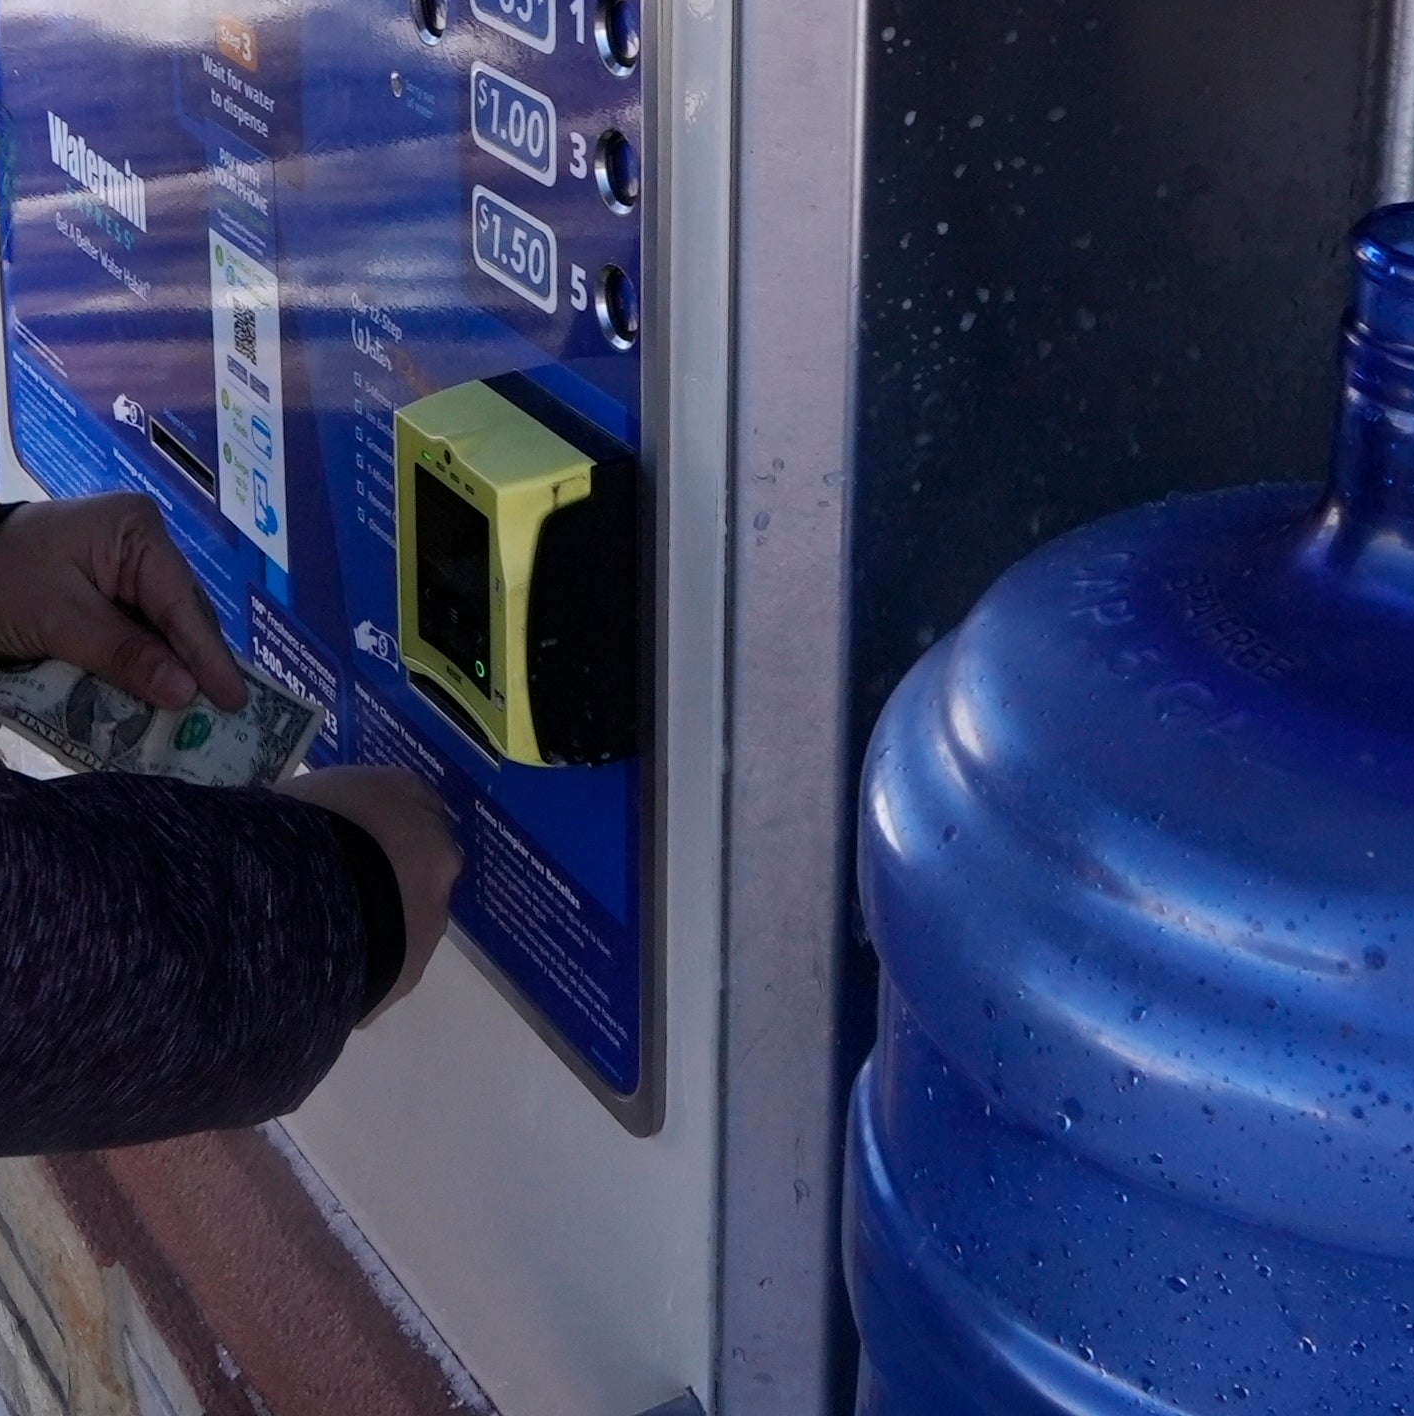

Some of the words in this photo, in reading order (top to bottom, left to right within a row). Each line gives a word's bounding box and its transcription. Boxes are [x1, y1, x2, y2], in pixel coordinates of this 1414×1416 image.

[220, 25, 240, 52] Step
[242, 32, 252, 62] 3
[202, 53, 226, 84] Wait
[227, 68, 242, 93] for
[243, 82, 275, 113] water
[210, 88, 222, 108] to
[223, 95, 268, 138] dispense
[477, 78, 545, 158] $1.00
[569, 132, 587, 179] 3
[238, 179, 269, 217] PHONE
[55, 211, 68, 235] Get
[69, 224, 76, 243] A
[76, 228, 99, 262] Better
[98, 246, 123, 281] Water
[479, 204, 545, 285] $1.50
[570, 262, 587, 311] 5
[351, 292, 369, 316] Our
[369, 305, 403, 344] 12-Step
[351, 317, 393, 371] Water
[267, 610, 300, 649] Freshness
[282, 644, 300, 666] water
[252, 636, 338, 735] 1-800-487-43
[498, 821, 529, 859] Limpiar
[530, 855, 544, 875] sus
[545, 867, 581, 910] Botellas
